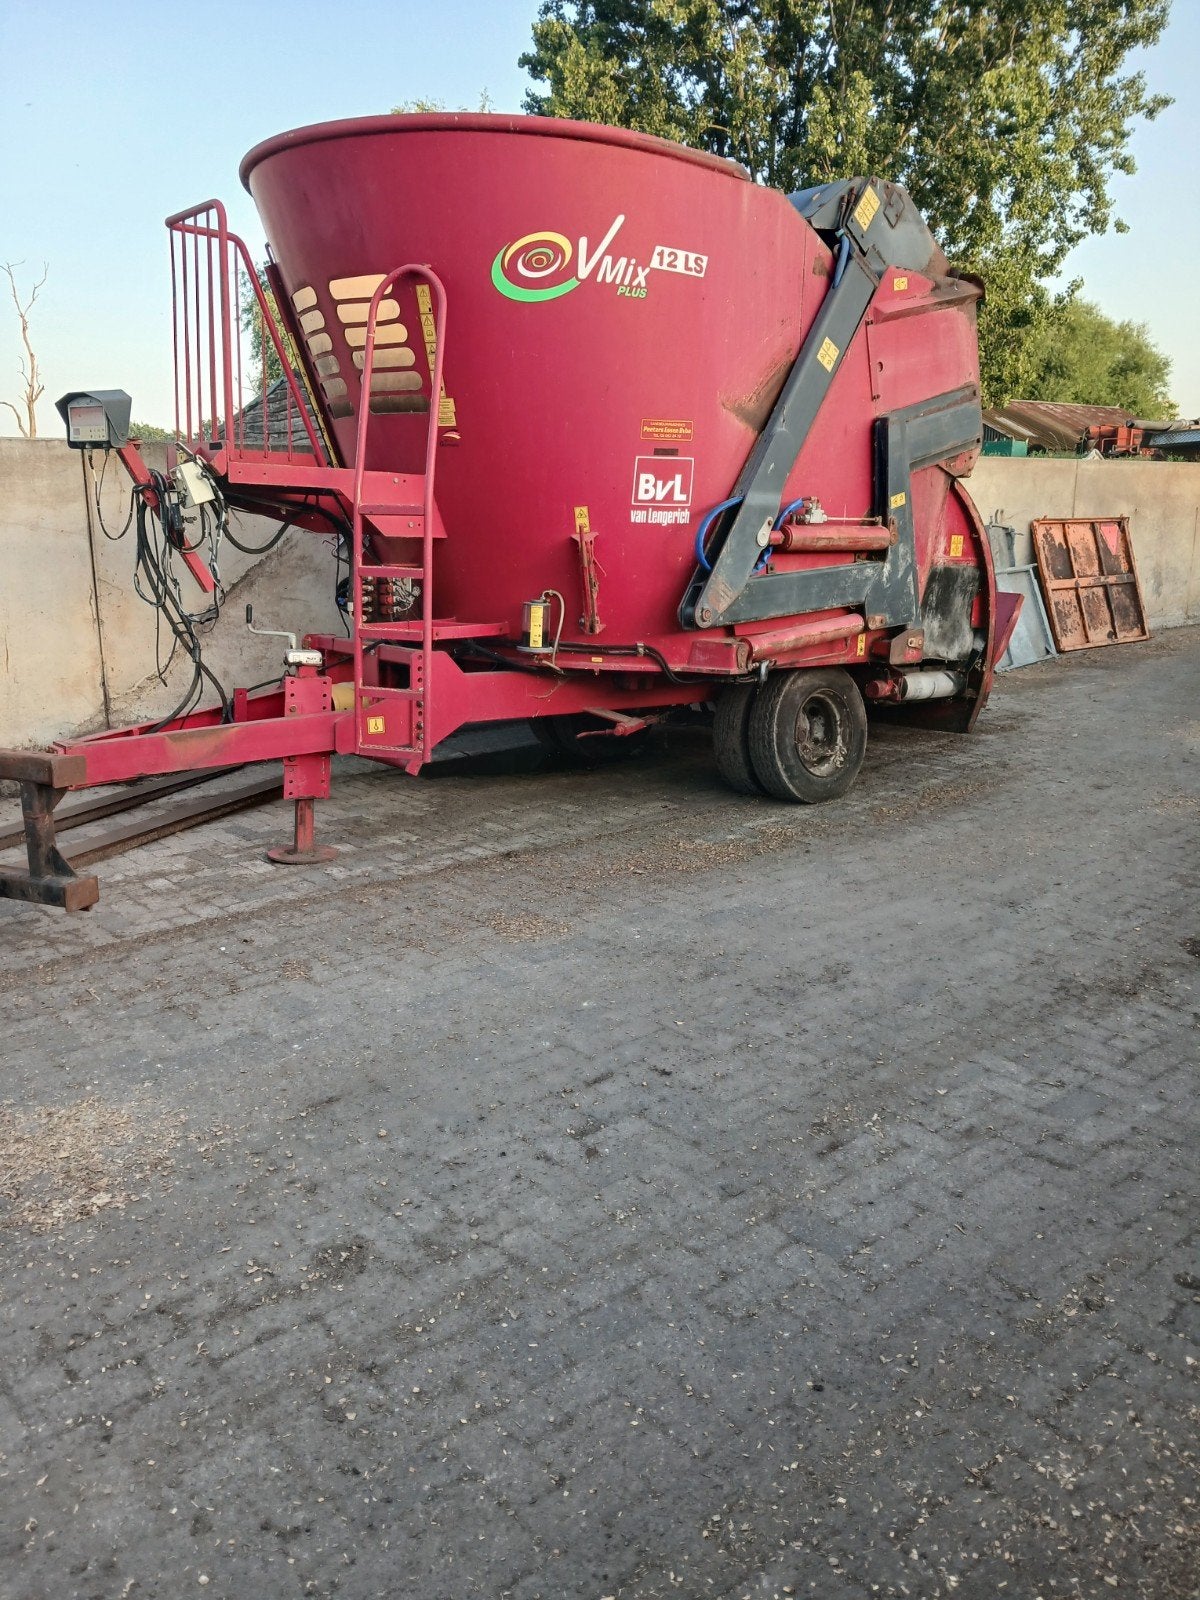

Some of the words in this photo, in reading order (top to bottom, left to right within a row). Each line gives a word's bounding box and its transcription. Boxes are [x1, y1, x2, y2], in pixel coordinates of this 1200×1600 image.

[656, 248, 679, 270] 12
[684, 253, 705, 276] LS
[616, 285, 648, 299] PLUS
[637, 473, 687, 501] BvL
[630, 510, 647, 524] van
[647, 507, 690, 527] Lengerich
